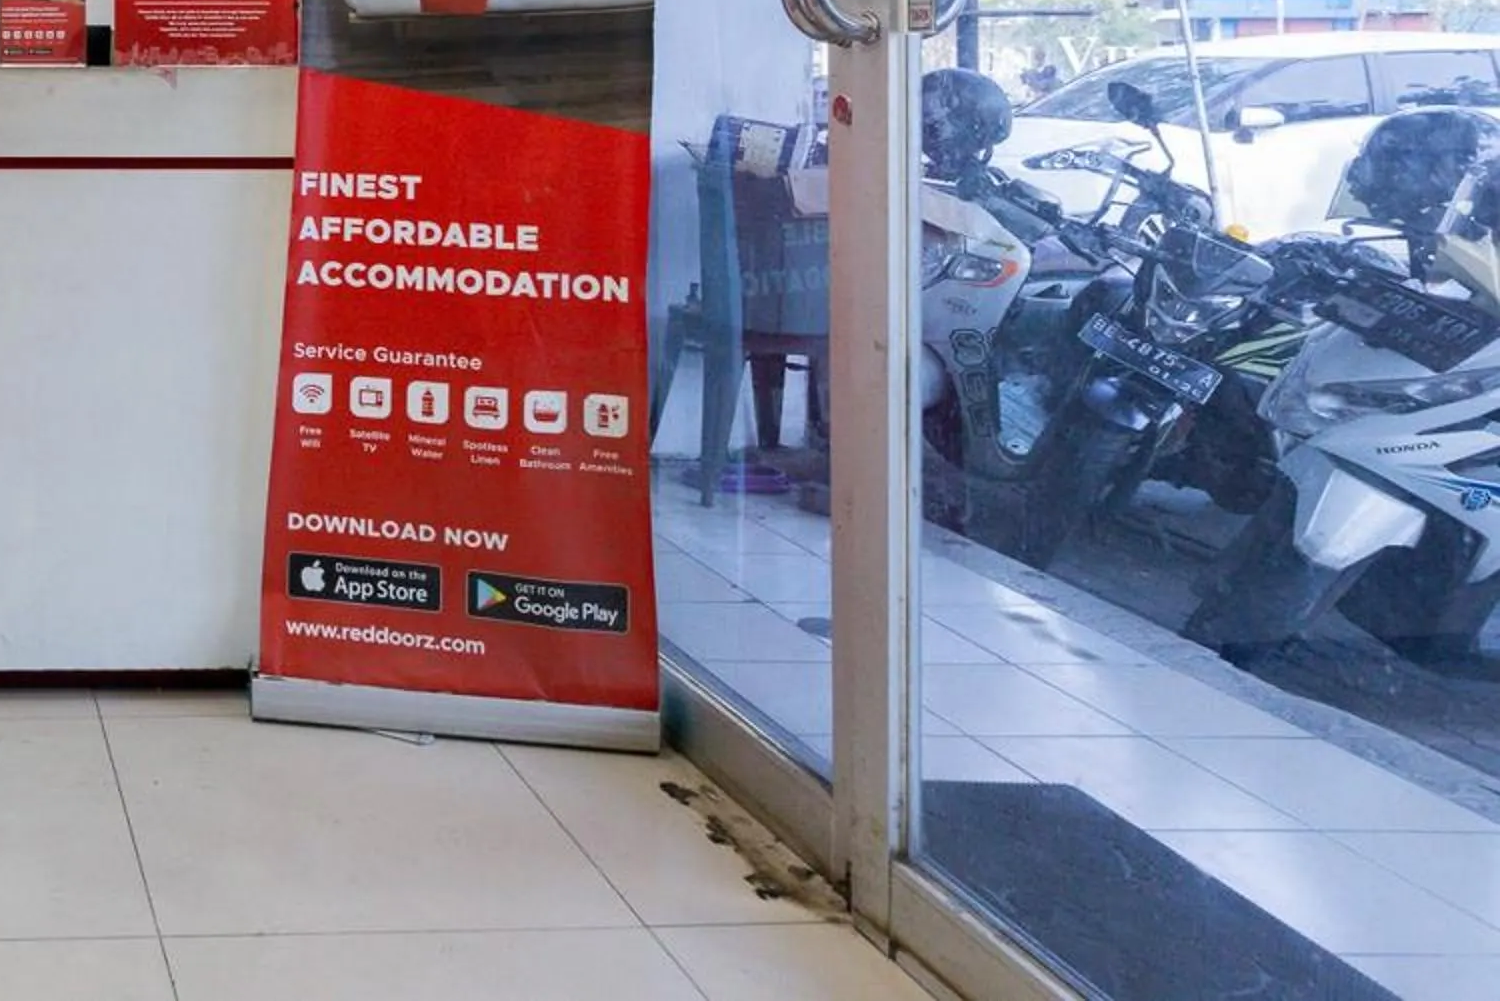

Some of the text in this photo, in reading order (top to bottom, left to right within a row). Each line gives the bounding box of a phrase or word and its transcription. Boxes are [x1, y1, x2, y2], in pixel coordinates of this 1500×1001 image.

[300, 171, 422, 200] FINEST
[298, 215, 540, 252] AFFORDABLE
[296, 261, 629, 303] ACCOMMODATION
[293, 342, 483, 371] Service Guarantee
[362, 442, 377, 454] TV
[408, 433, 447, 447] Mineral
[462, 440, 509, 456] Spotless
[1376, 441, 1441, 456] HONDA
[411, 448, 443, 461] Water
[470, 454, 501, 466] Linen
[530, 445, 561, 458] Clean
[287, 512, 510, 552] DOWNLOAD NOW
[335, 562, 427, 581] Download on the
[334, 575, 429, 603] App Store
[514, 582, 565, 598] GET IT ON
[514, 595, 619, 627] Google Play
[285, 620, 486, 655] www.reddoorz.com
